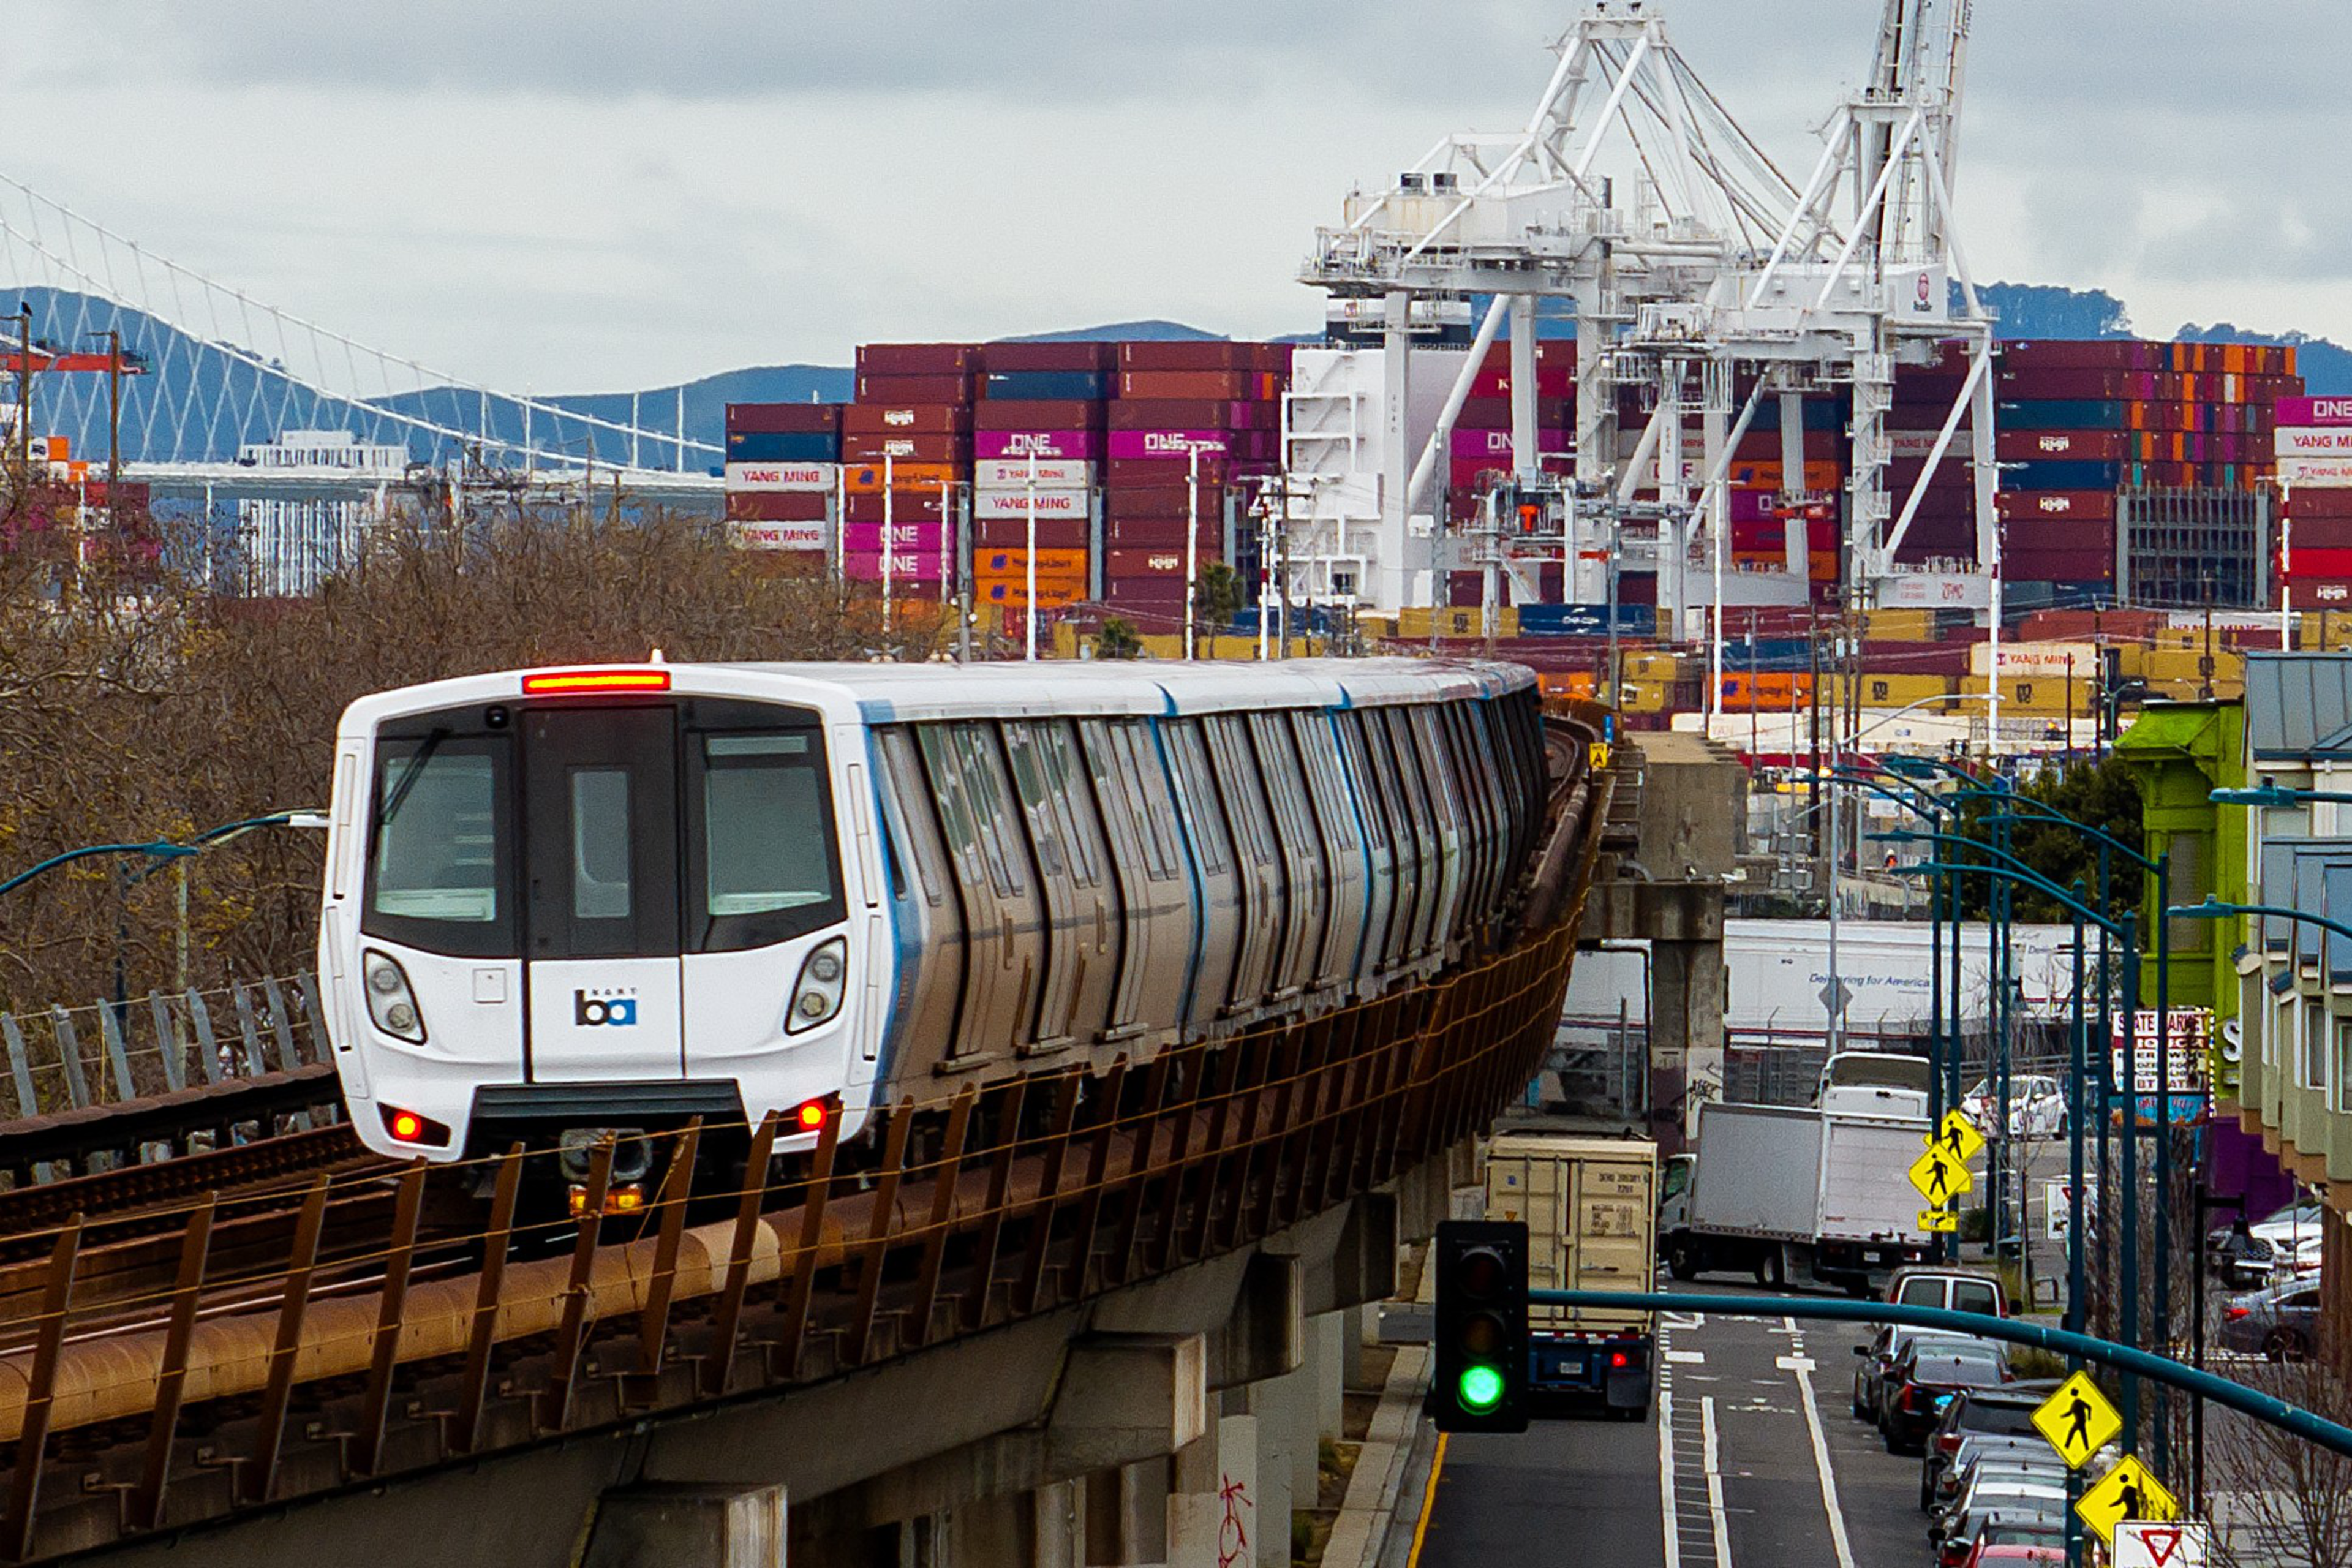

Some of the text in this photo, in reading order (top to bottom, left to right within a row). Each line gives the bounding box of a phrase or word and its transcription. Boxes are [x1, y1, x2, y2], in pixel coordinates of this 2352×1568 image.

[1011, 434, 1050, 449] ONE
[1488, 432, 1514, 449] ON
[2293, 435, 2332, 448] YANG
[742, 471, 820, 483] YANG MING
[993, 498, 1071, 510] YANG MING
[783, 529, 819, 541] MING
[1868, 974, 1884, 986] for
[1885, 975, 1930, 988] America
[2119, 1014, 2155, 1031] SATE
